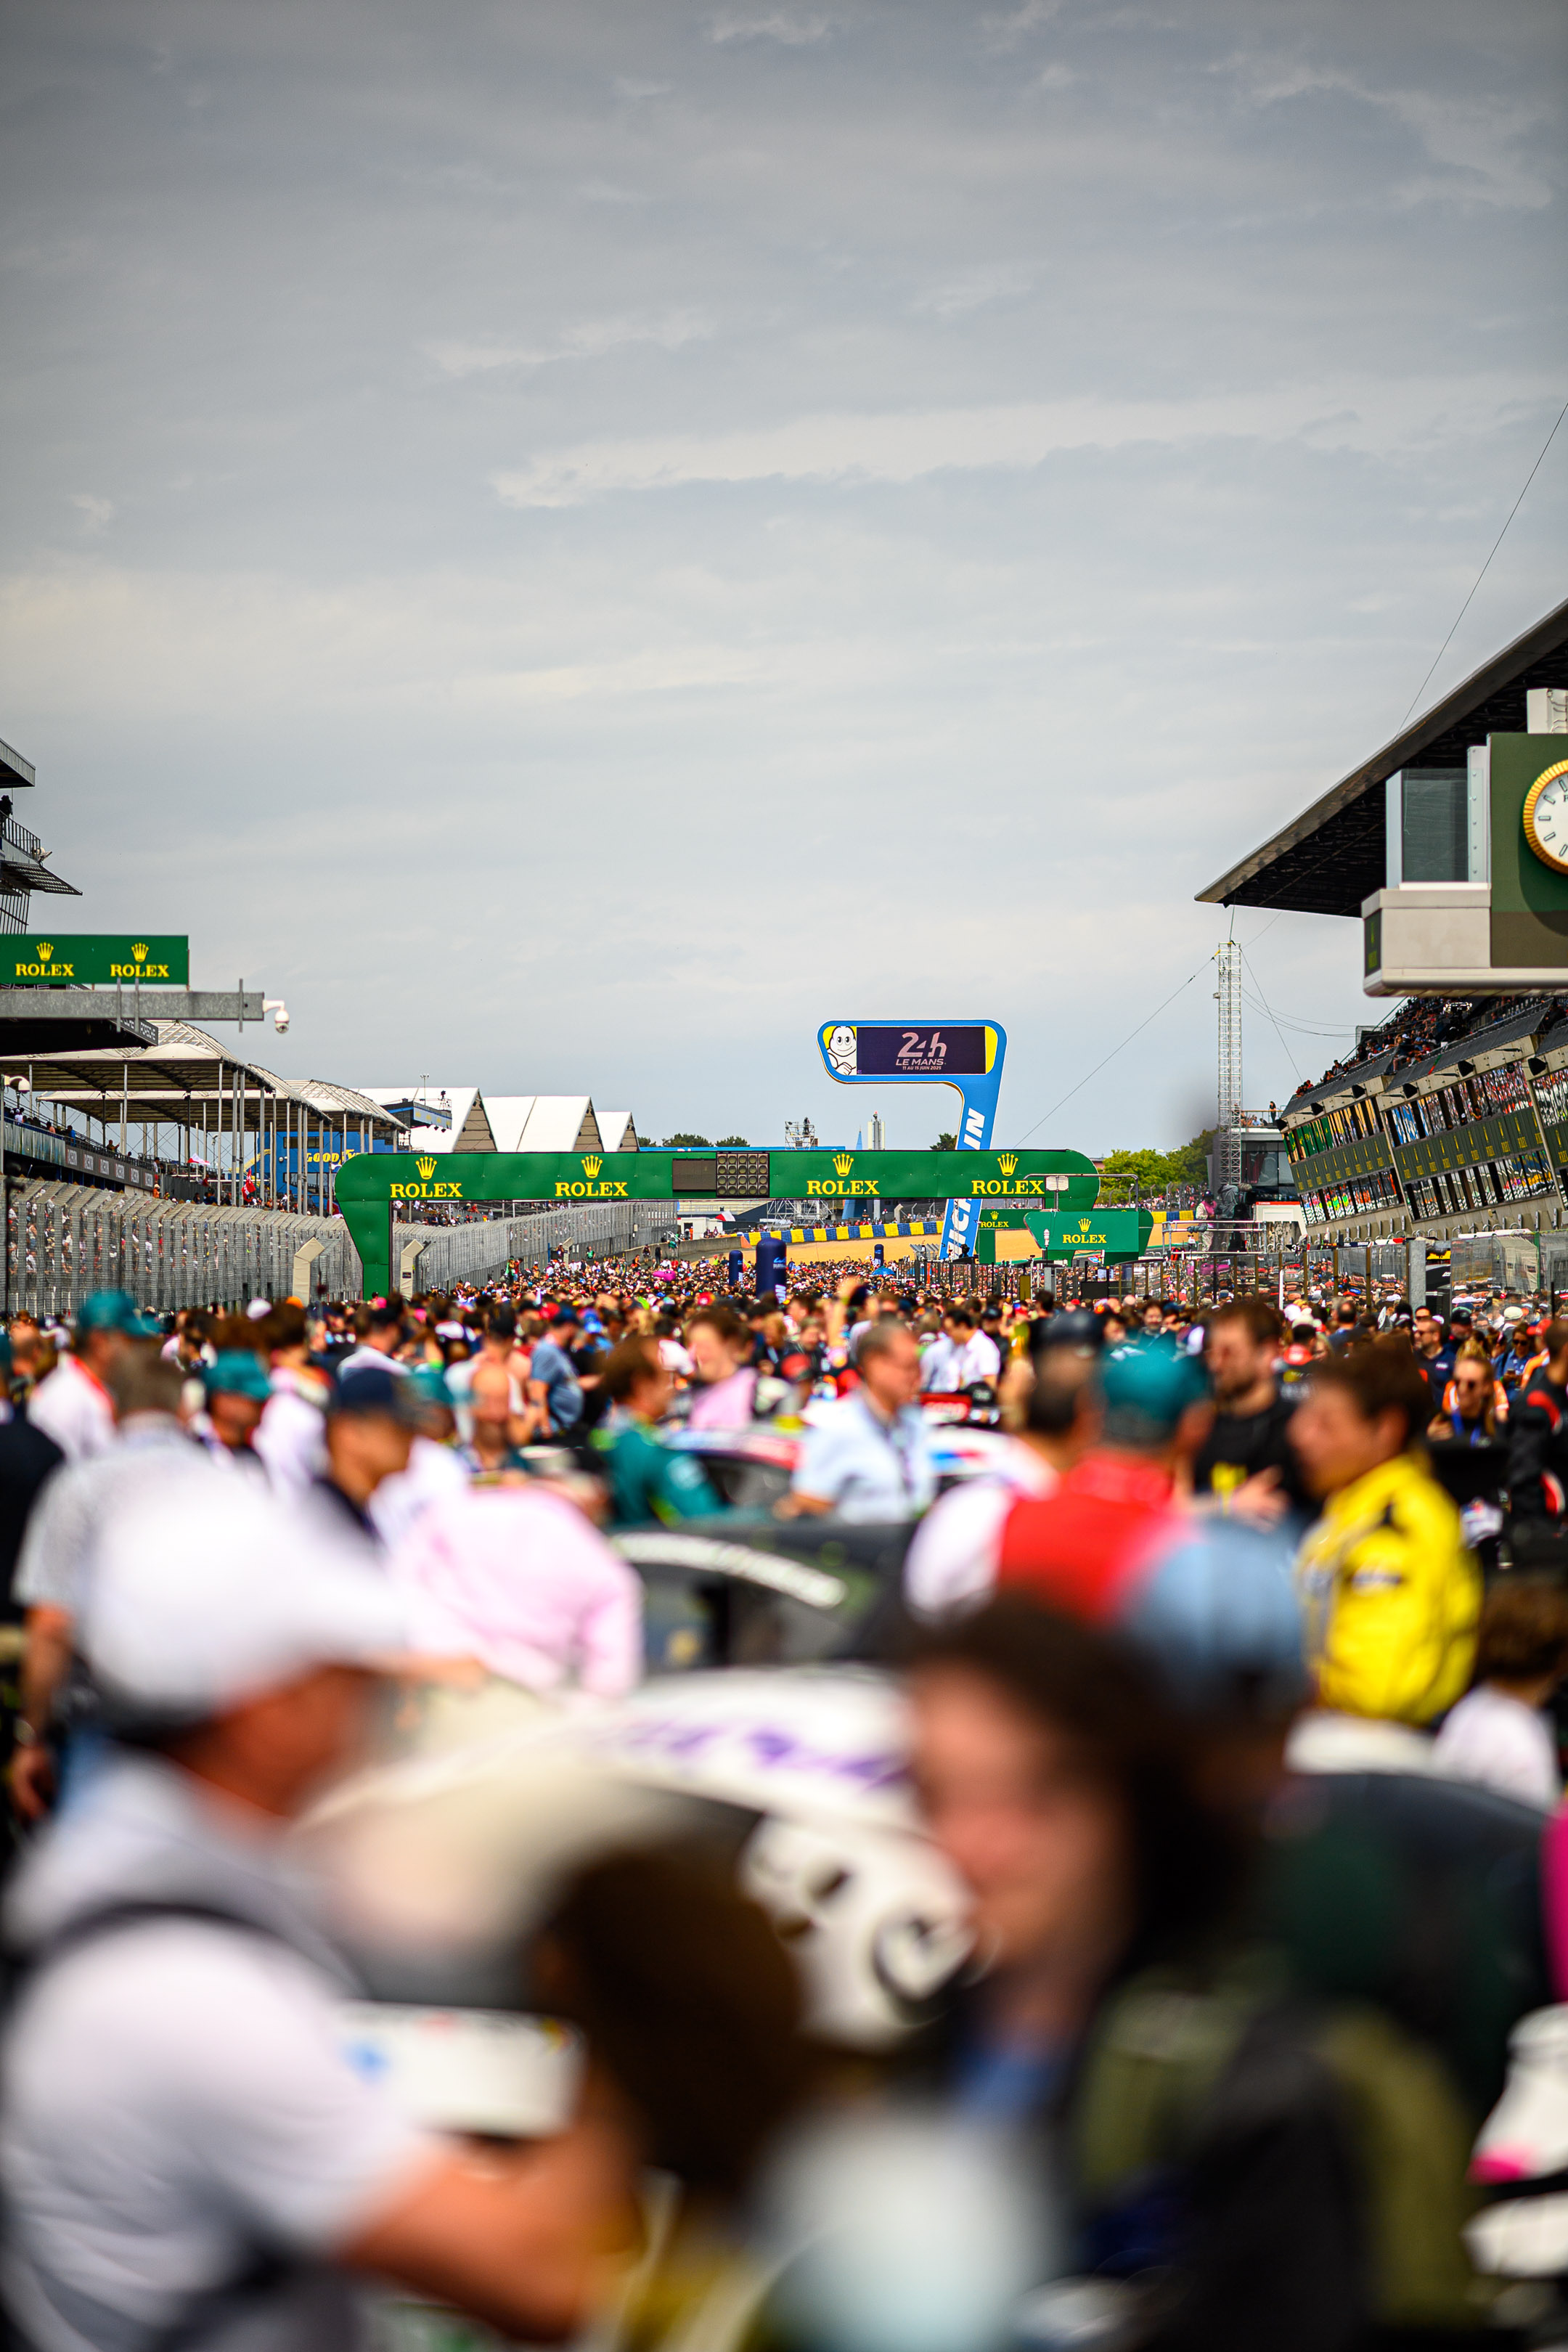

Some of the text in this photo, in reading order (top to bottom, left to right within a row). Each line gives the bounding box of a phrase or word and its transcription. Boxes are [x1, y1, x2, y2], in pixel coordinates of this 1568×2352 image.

[16, 963, 169, 978] ROLEX ROLEX
[897, 1032, 947, 1058] 24h
[390, 1183, 463, 1199] ROLEX
[555, 1181, 629, 1197] ROLEX
[807, 1180, 880, 1196] ROLEX
[971, 1180, 1045, 1195] ROLEX
[1062, 1234, 1107, 1244] ROLEX
